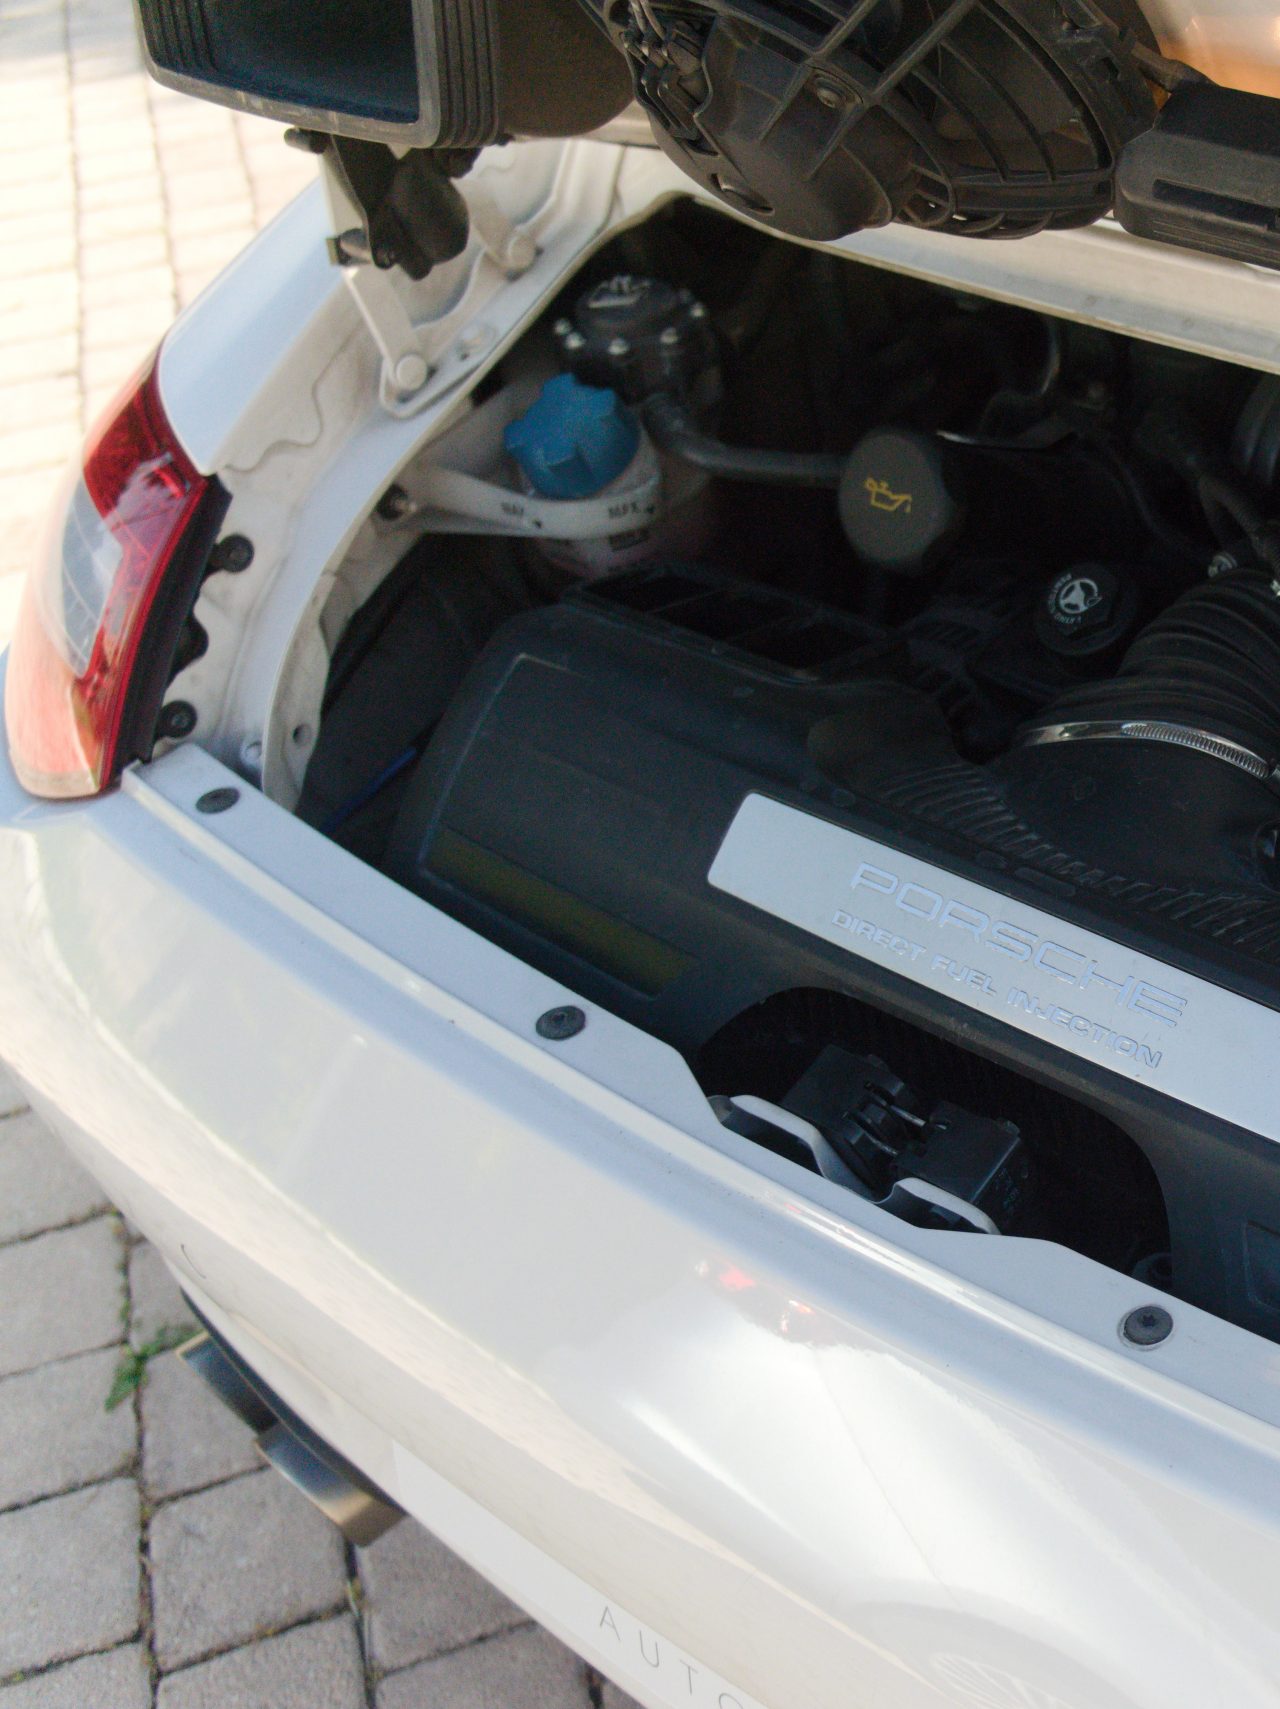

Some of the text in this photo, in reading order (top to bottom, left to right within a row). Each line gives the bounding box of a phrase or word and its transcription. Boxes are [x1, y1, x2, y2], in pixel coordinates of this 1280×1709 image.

[831, 909, 1163, 1069] DIRECT FUEL INJECTION
[850, 861, 1188, 1027] PORSCHE
